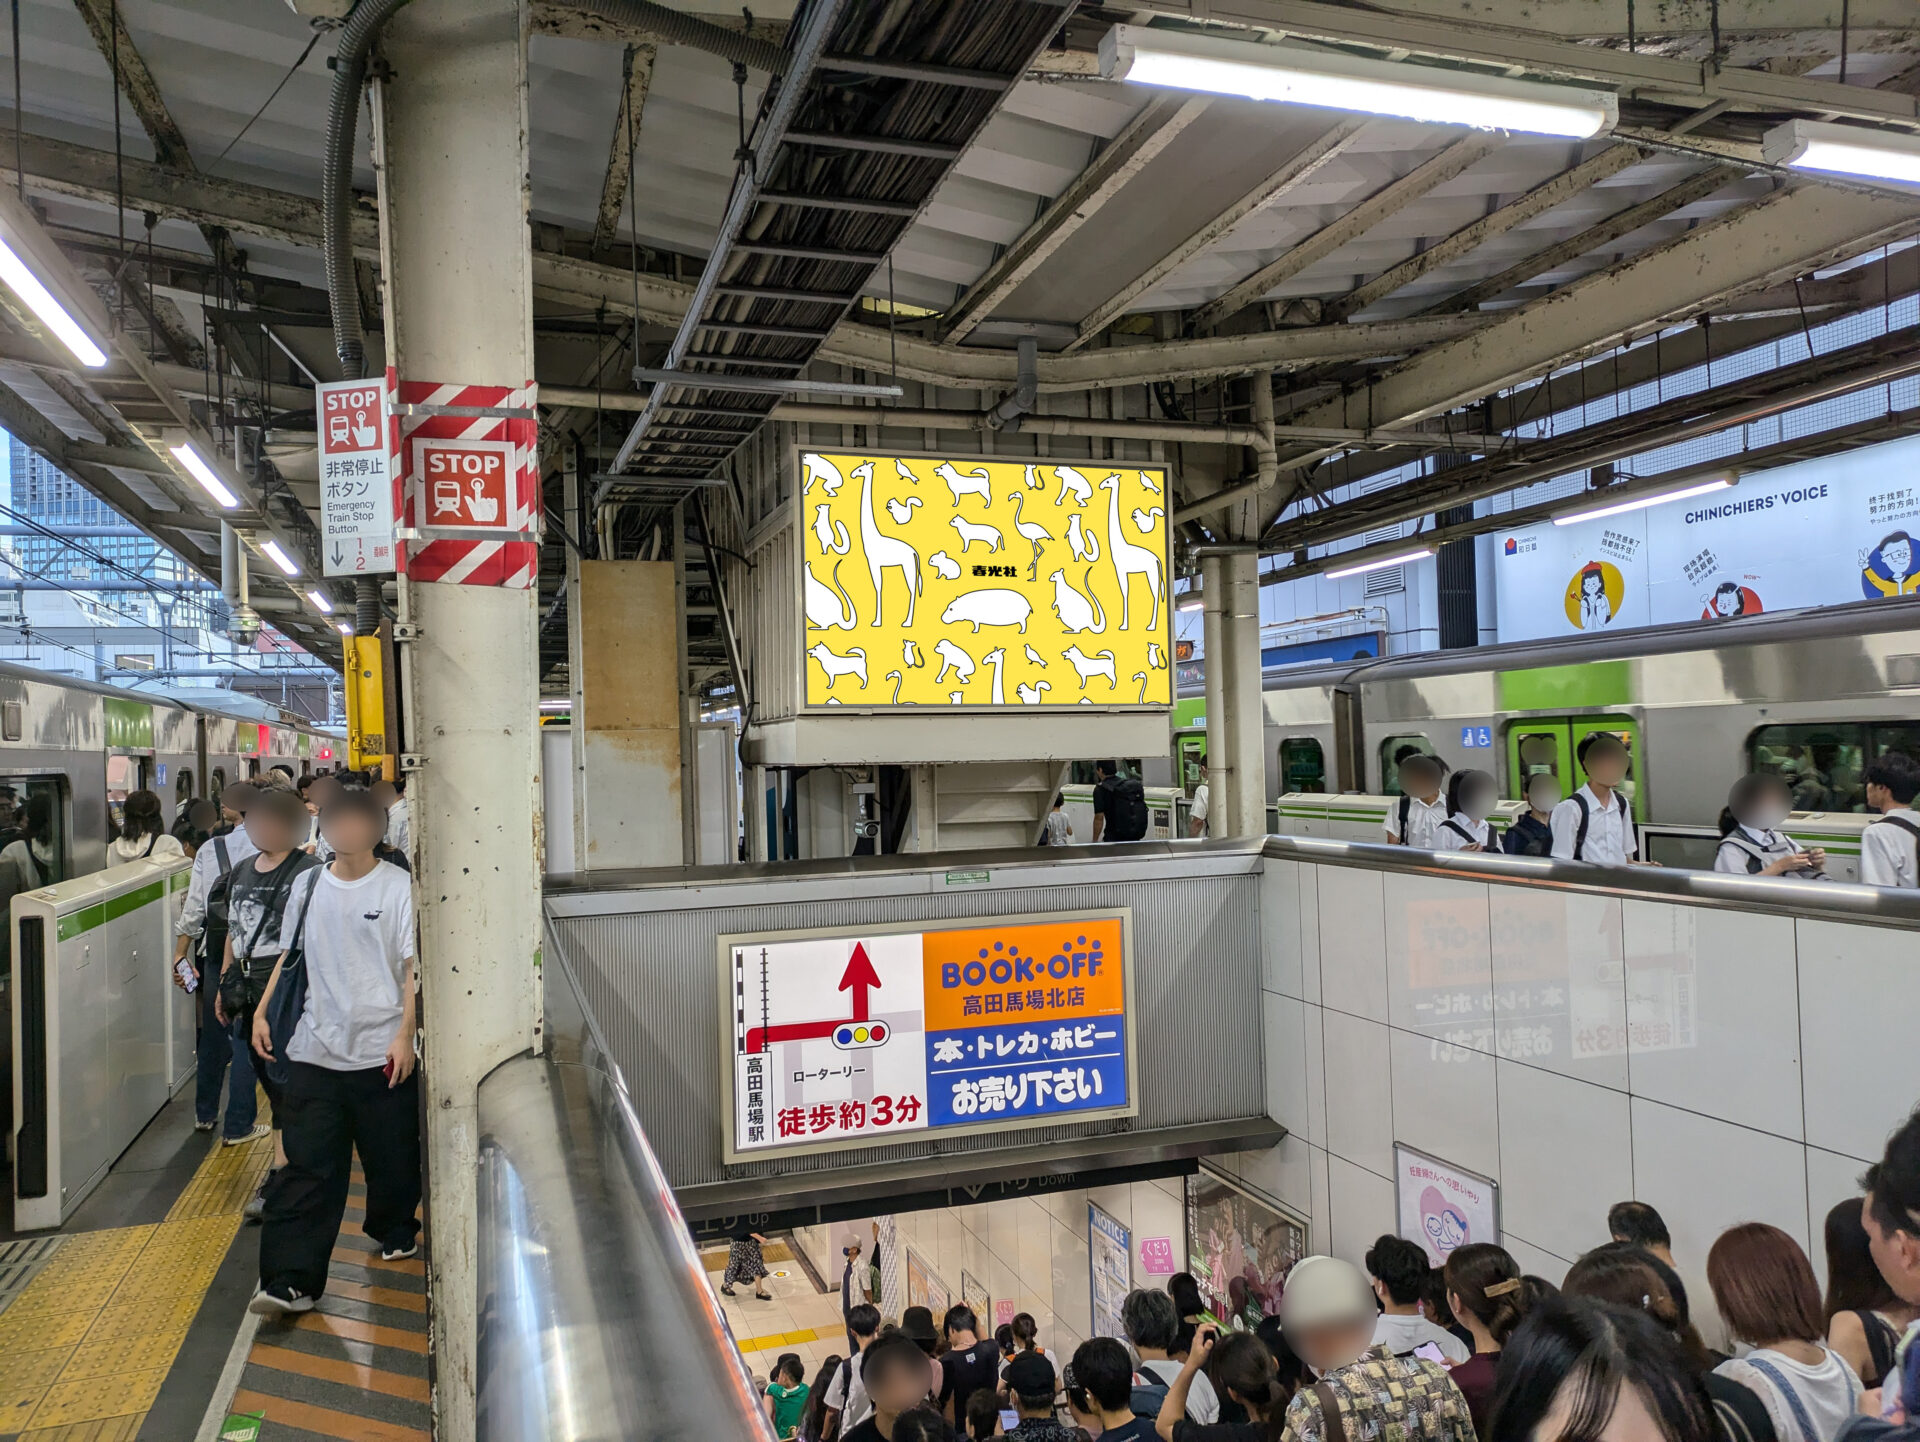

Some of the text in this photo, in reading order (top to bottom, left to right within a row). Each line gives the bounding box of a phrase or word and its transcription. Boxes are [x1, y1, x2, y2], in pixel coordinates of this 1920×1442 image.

[327, 391, 377, 411] STOP
[326, 458, 384, 479] 非常停止
[429, 454, 501, 475] STOP
[327, 481, 369, 499] ボタン
[327, 501, 376, 513] Emergency
[1685, 484, 1828, 524] CHINICHIERS' VOICE
[328, 511, 375, 524] Train Stop
[328, 524, 359, 535] Button
[972, 565, 1018, 578] 春光社
[963, 986, 1086, 1016] 高田馬場北店
[934, 1022, 1117, 1063] 本・トレカ・ホビー
[793, 1066, 867, 1083] ローターリー
[747, 1057, 765, 1143] 高田馬場駅
[952, 1067, 1103, 1116] お売り下さい
[778, 1094, 922, 1138] 徒歩約3分
[1038, 1171, 1076, 1187] Down
[1409, 1165, 1480, 1204] 妊産婦さんへの思いやり
[749, 1211, 769, 1228] Up
[1093, 1209, 1125, 1245] NOTICE
[1146, 1240, 1169, 1257] くだり
